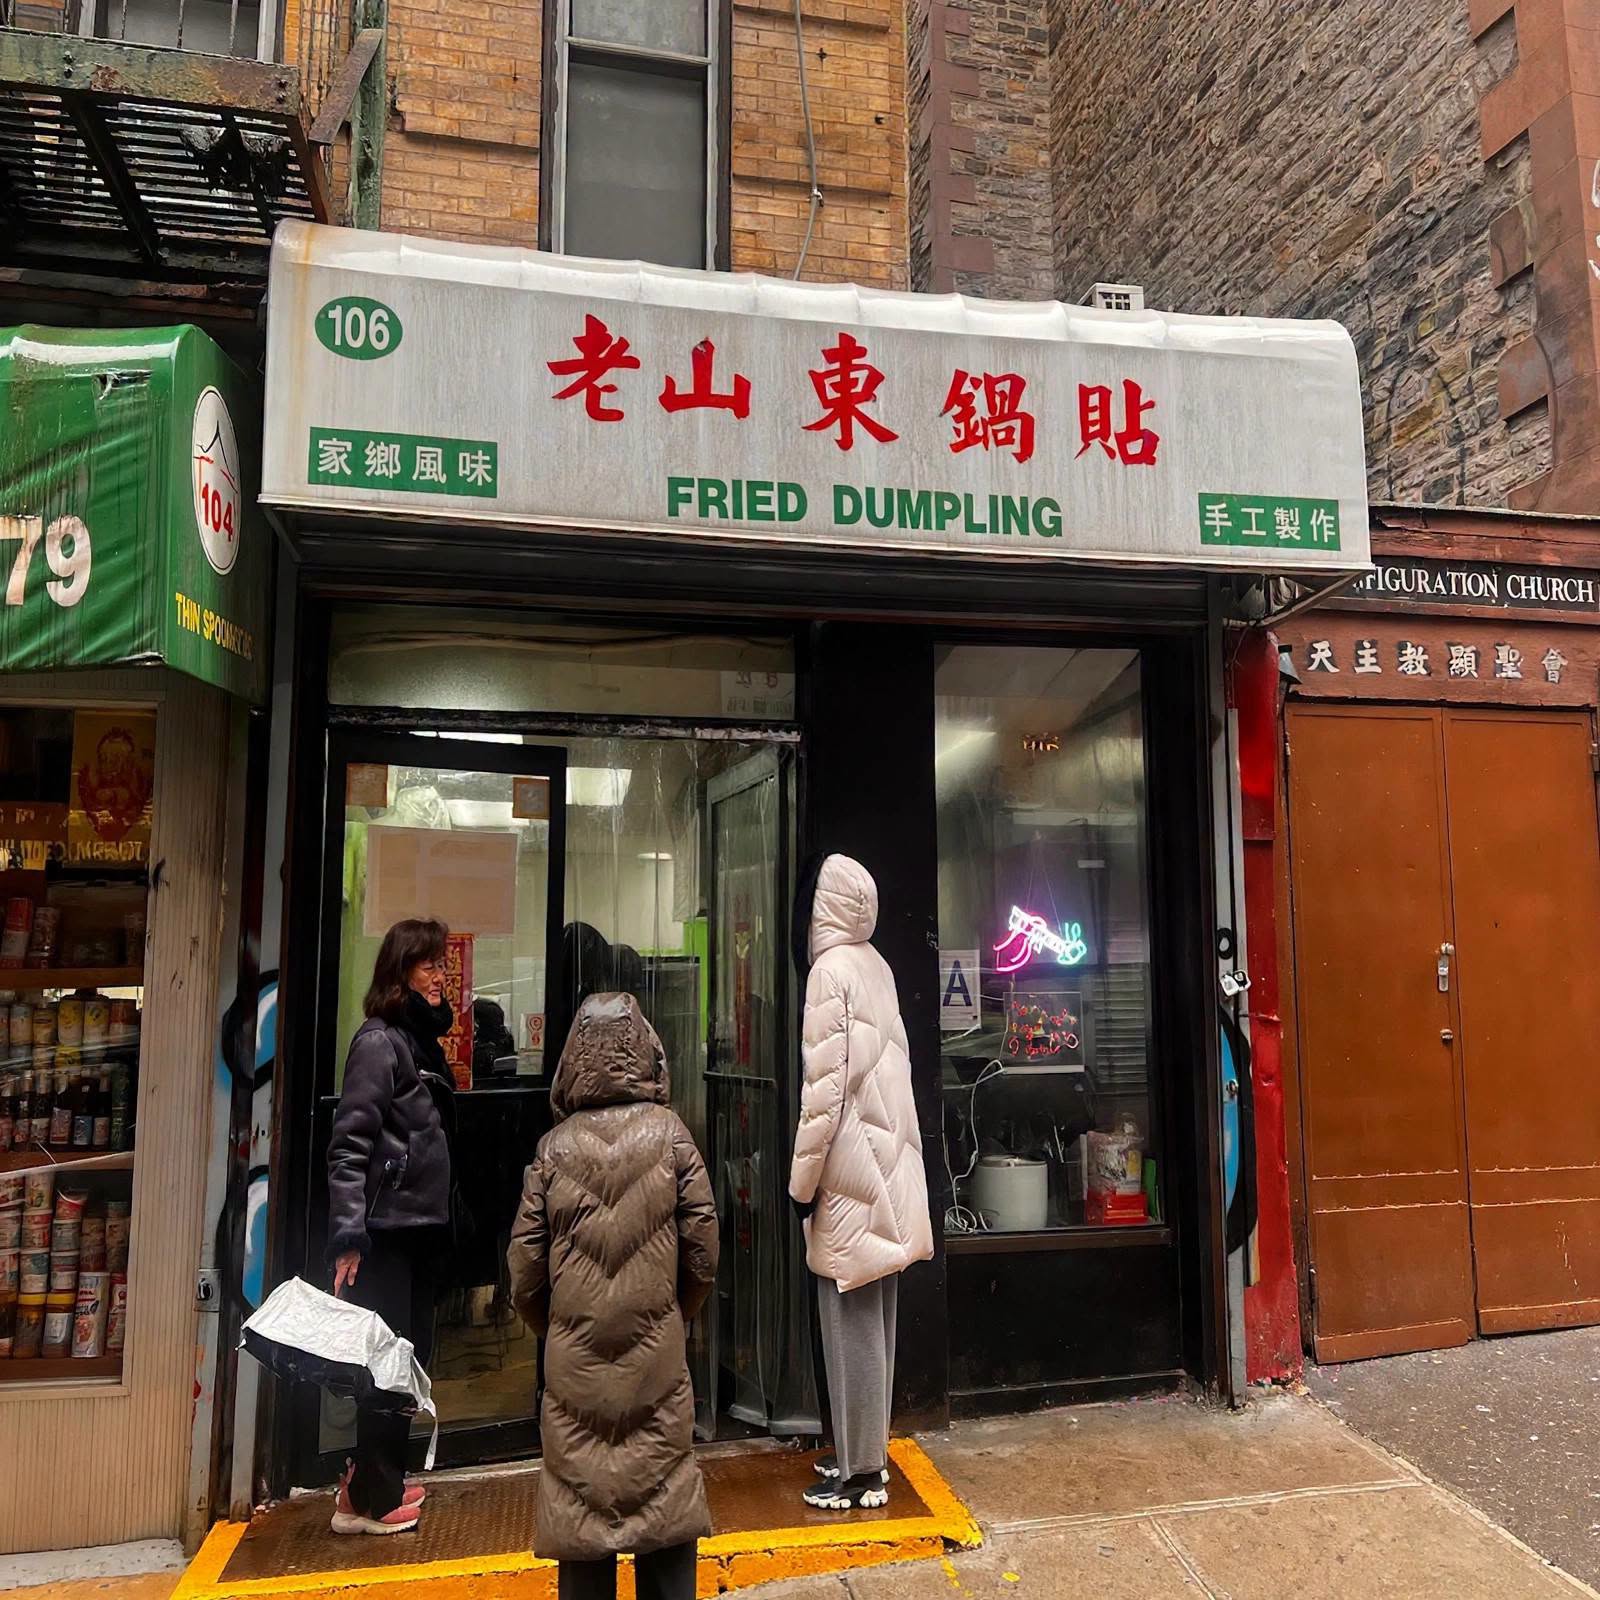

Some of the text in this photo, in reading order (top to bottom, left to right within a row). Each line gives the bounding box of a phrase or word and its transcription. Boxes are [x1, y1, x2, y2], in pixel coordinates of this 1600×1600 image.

[328, 304, 390, 350] 106
[547, 313, 1159, 466] 老山東鍋貼
[317, 437, 494, 486] 家鄉風味
[201, 482, 234, 543] 104
[667, 476, 1063, 538] FRIED DUMPLING
[1204, 503, 1336, 543] 手工製作
[0, 515, 92, 607] 79
[1353, 566, 1594, 603] FIGURATION CHURCH
[1307, 640, 1568, 684] 天主教顯聖會
[942, 959, 972, 1007] A
